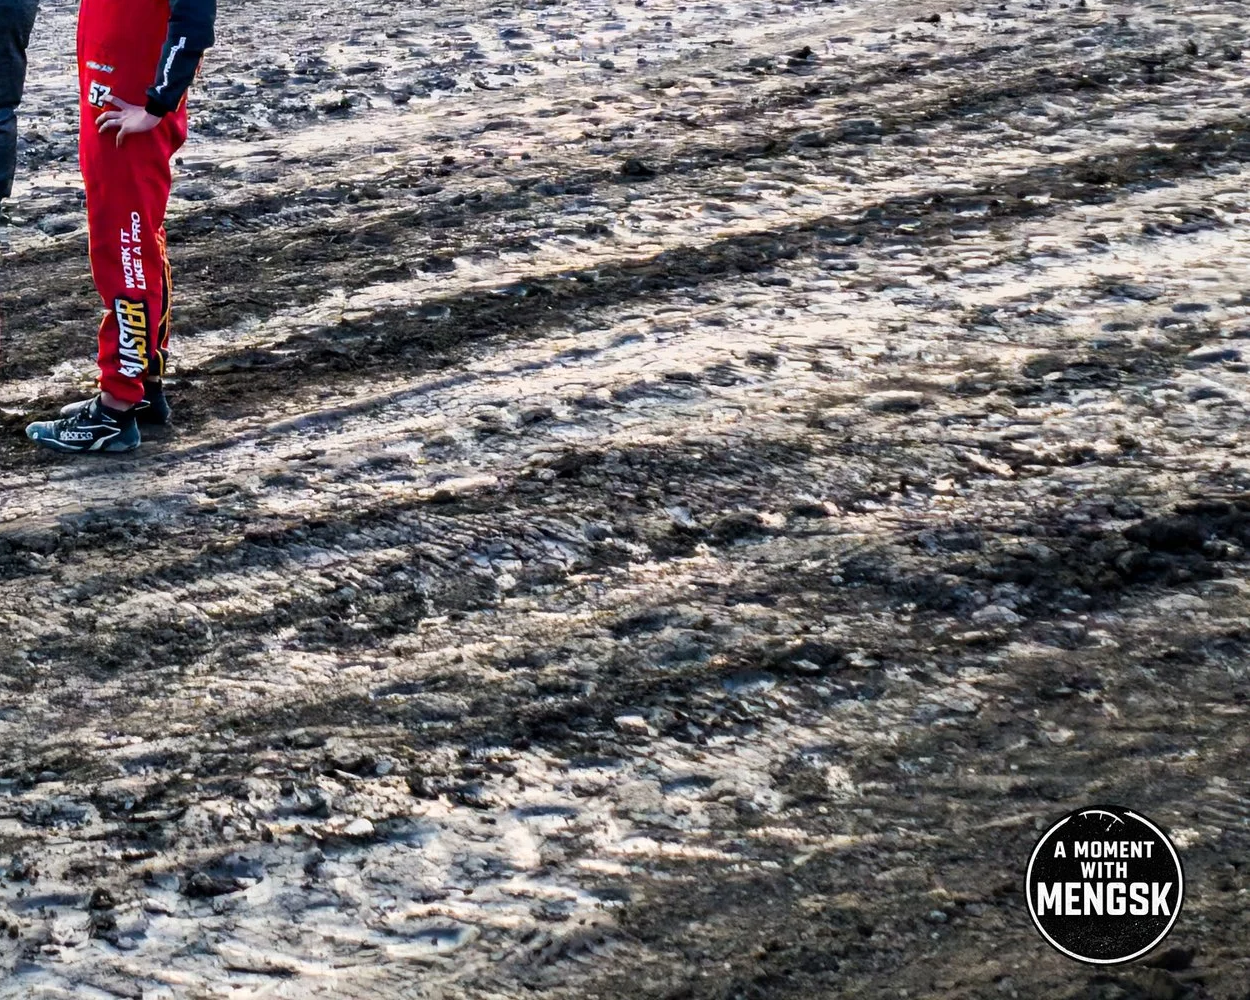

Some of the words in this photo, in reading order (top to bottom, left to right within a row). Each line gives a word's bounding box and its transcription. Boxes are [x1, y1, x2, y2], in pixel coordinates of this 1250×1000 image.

[121, 228, 131, 244] IT
[131, 211, 141, 243] PRO
[133, 246, 142, 256] A
[121, 246, 135, 289] WORK
[132, 258, 147, 290] LIKE
